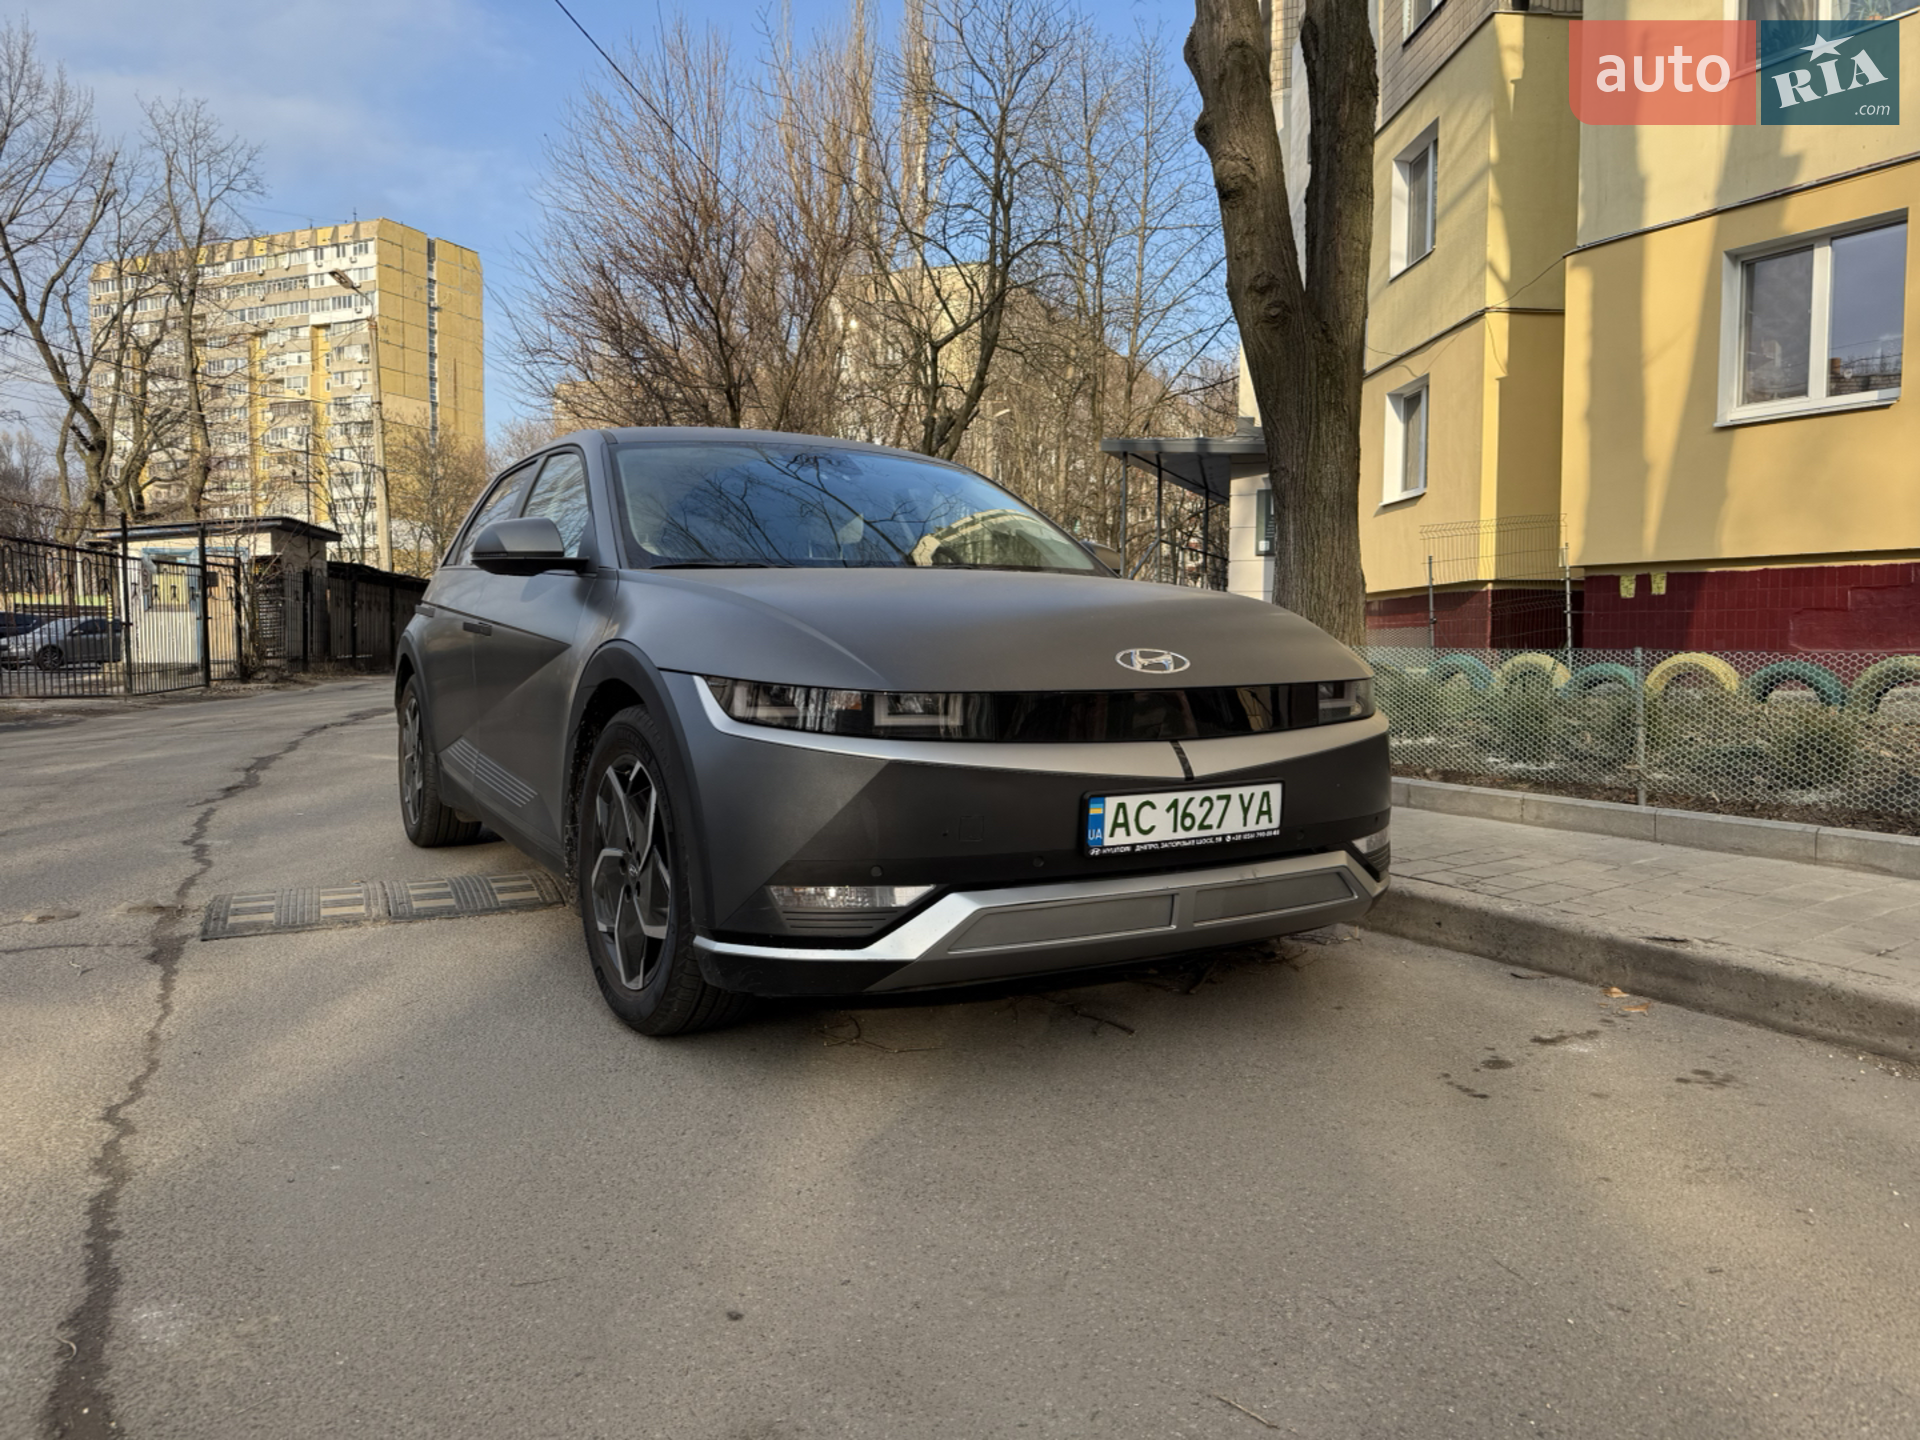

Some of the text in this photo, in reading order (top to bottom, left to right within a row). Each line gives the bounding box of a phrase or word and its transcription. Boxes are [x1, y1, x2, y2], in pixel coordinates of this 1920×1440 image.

[1108, 790, 1273, 838] AC 1627 YA
[1087, 828, 1103, 841] UA
